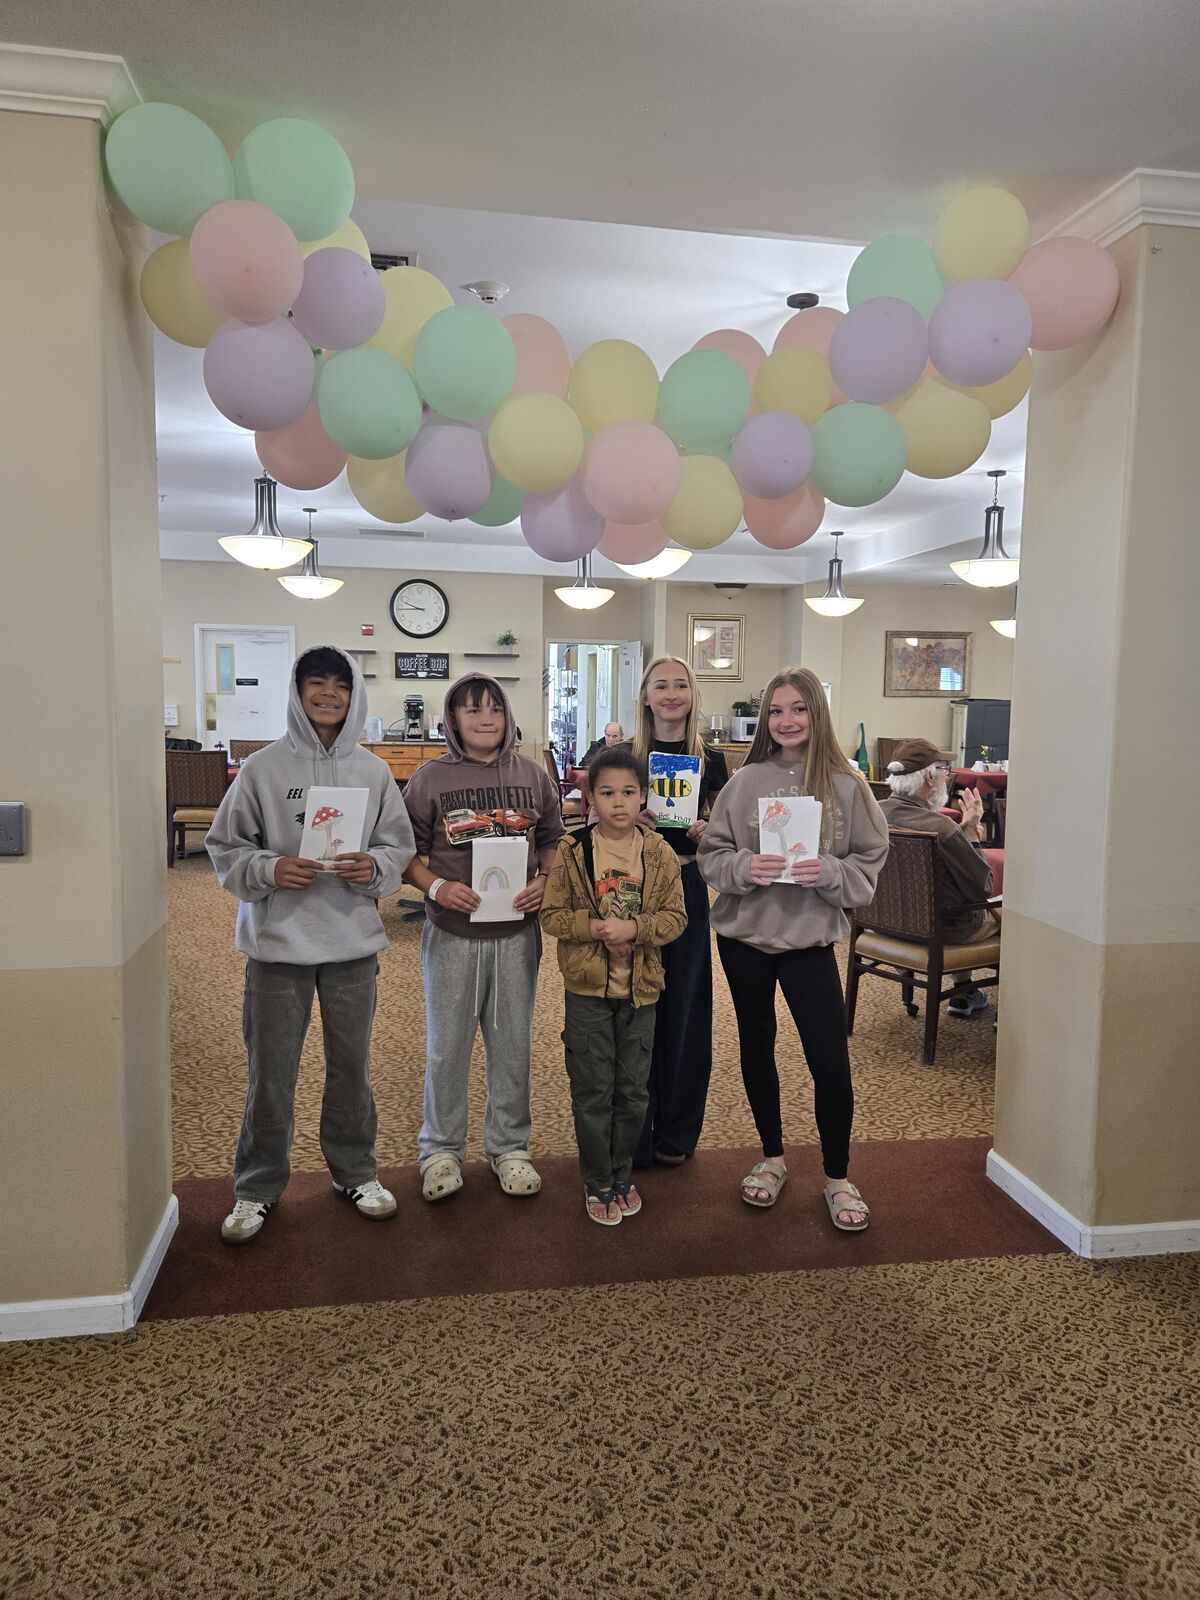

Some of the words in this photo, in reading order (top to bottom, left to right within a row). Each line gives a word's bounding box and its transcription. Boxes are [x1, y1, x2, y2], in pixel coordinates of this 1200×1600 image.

[397, 657, 428, 669] COFFEE
[430, 657, 448, 669] BAR
[286, 787, 304, 800] EEL
[439, 789, 465, 806] CHEVY
[465, 785, 535, 811] CORVETTE
